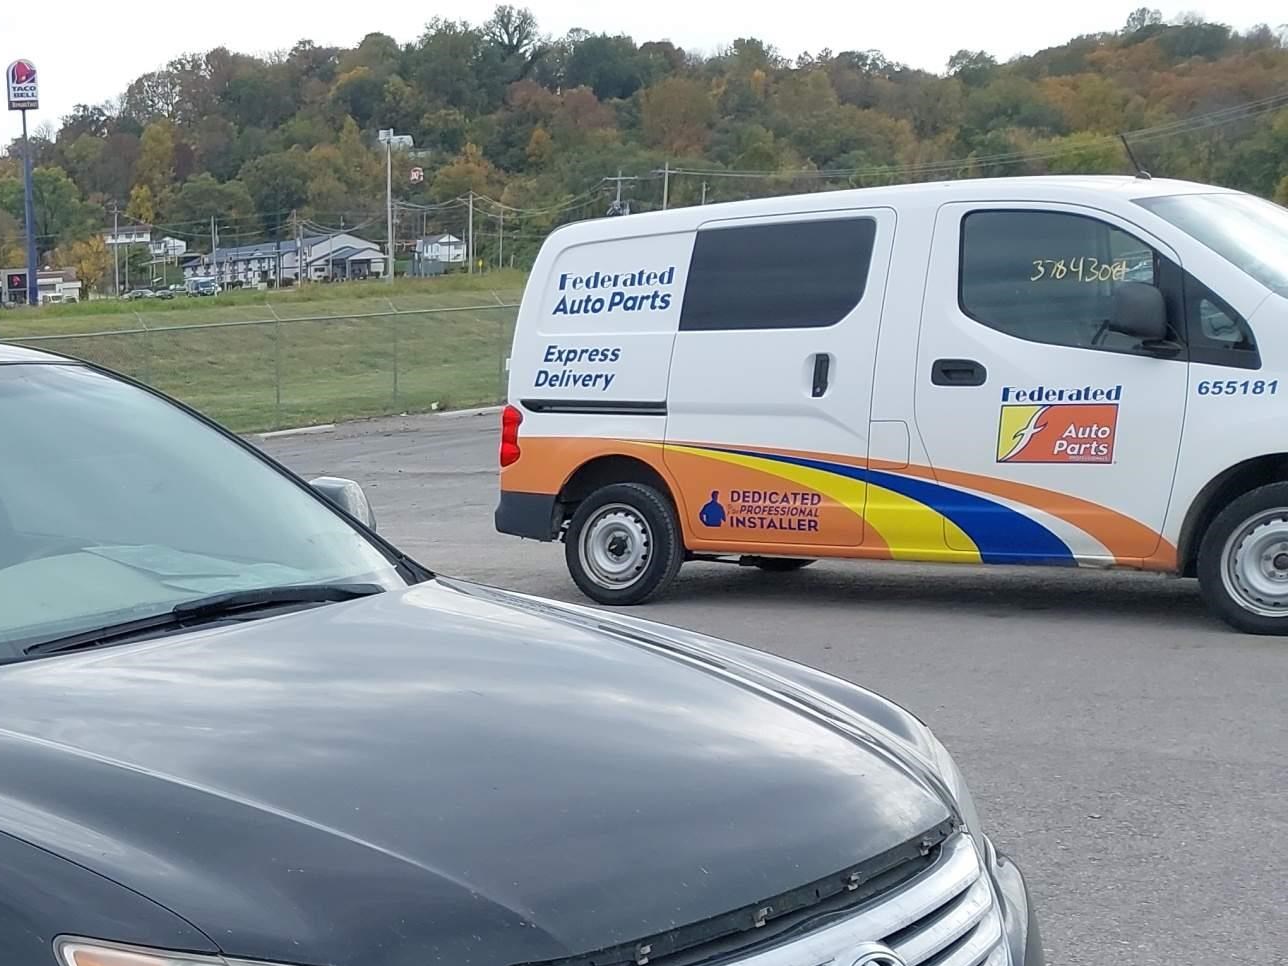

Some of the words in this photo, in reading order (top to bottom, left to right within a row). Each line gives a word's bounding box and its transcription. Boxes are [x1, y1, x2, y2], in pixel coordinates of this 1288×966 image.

[558, 266, 675, 291] Federated
[551, 293, 605, 316] Auto
[608, 289, 672, 313] Parts
[543, 344, 621, 366] Express
[534, 369, 615, 391] Delivery
[1197, 380, 1279, 396] 655181
[1001, 385, 1123, 402] Federated
[1062, 423, 1111, 439] Auto
[1053, 440, 1109, 456] Parts
[730, 490, 822, 506] DEDICATED
[740, 504, 820, 517] PROFESSIONAL
[730, 516, 819, 532] INSTALLER
